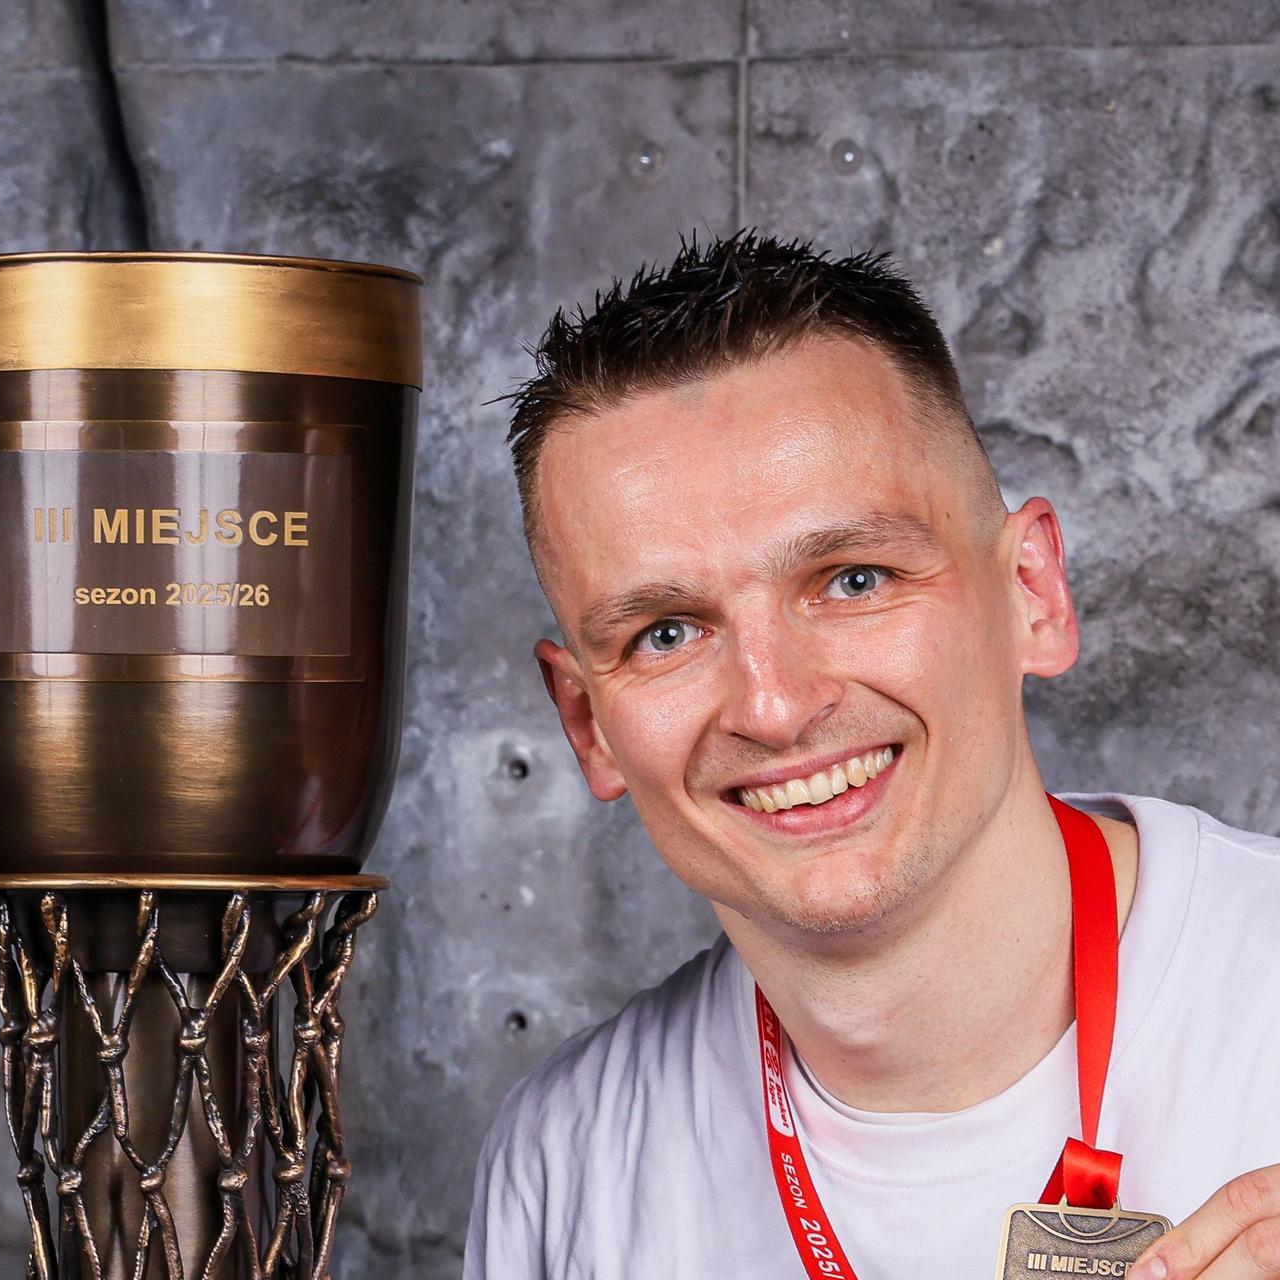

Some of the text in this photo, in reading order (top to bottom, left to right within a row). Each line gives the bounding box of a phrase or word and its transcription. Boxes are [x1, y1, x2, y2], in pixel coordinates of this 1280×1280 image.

[33, 507, 310, 547] III MIEJSCE
[74, 583, 271, 607] sezon 2025/26
[781, 1152, 808, 1209] SEZON
[1027, 1253, 1047, 1271] III
